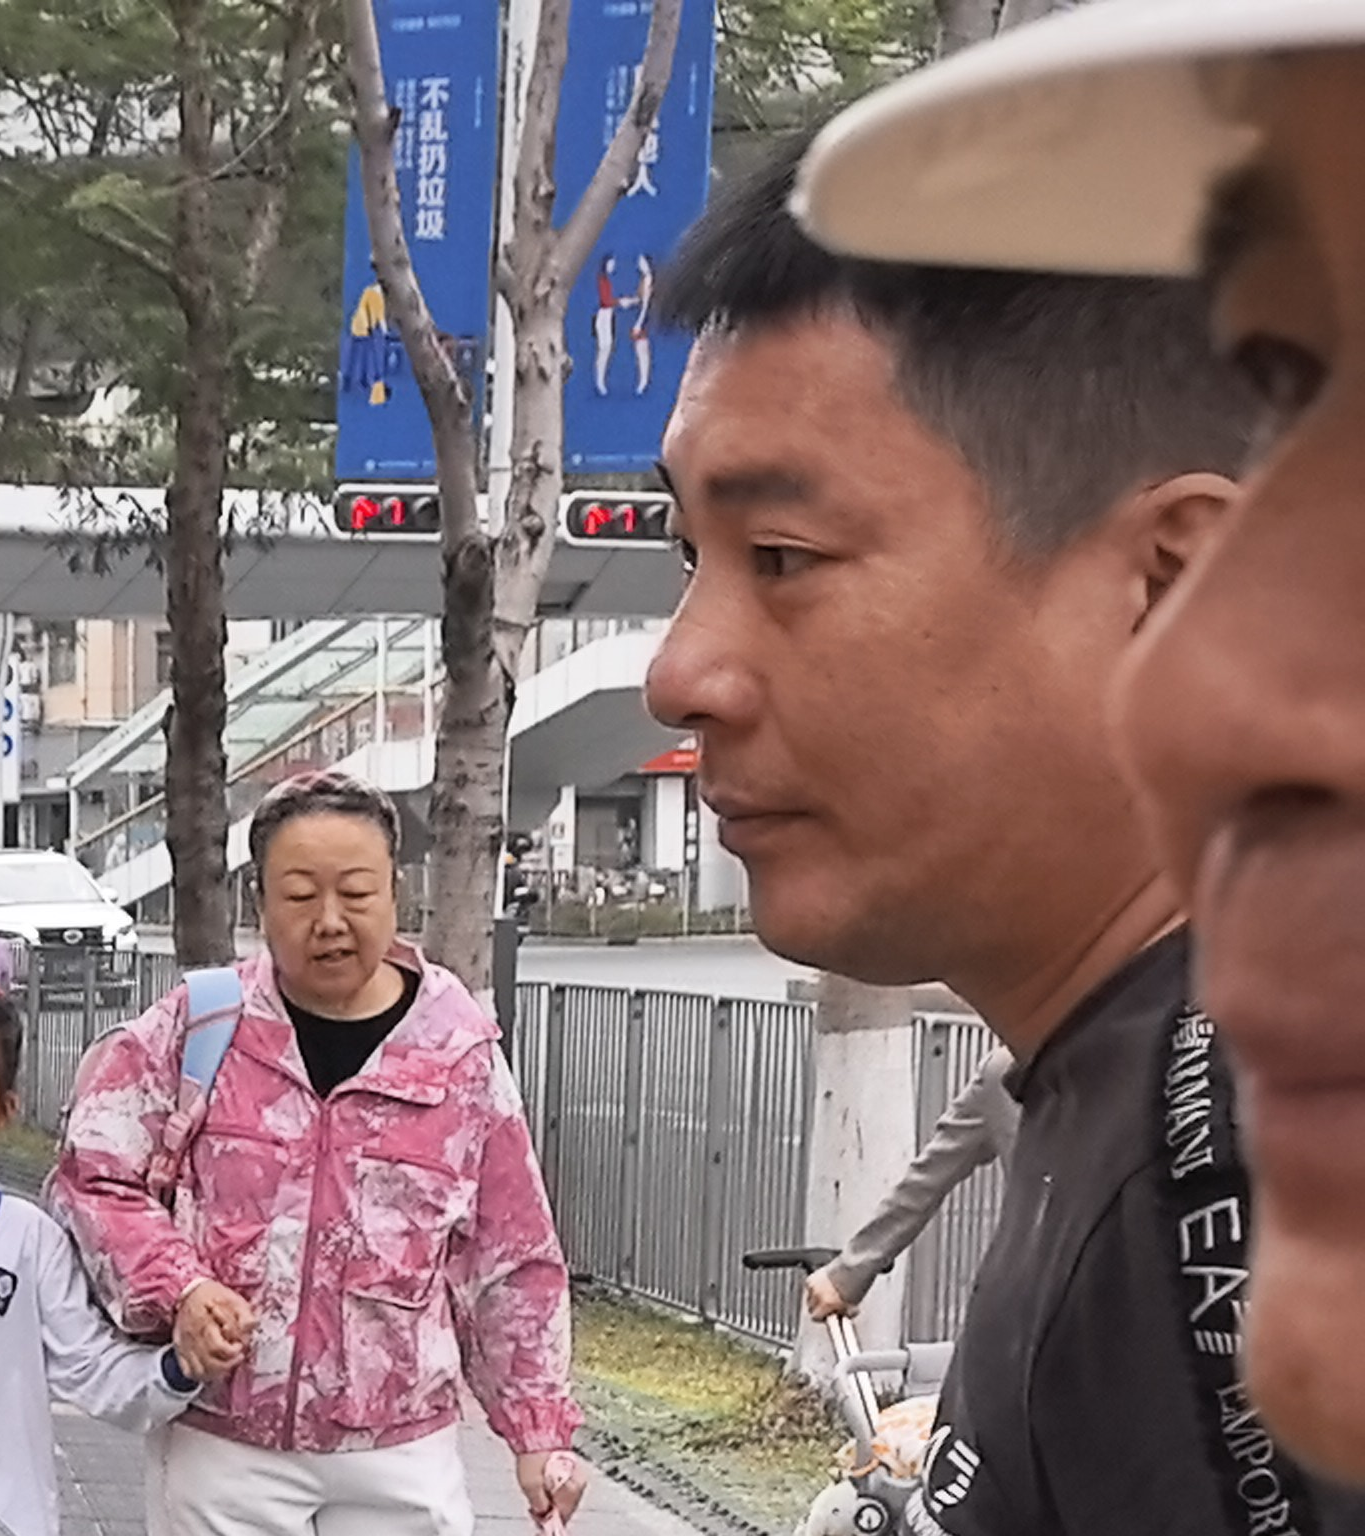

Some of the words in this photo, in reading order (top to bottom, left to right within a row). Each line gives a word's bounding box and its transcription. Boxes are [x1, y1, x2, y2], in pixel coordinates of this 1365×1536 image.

[415, 76, 450, 241] 不乱扔垃圾
